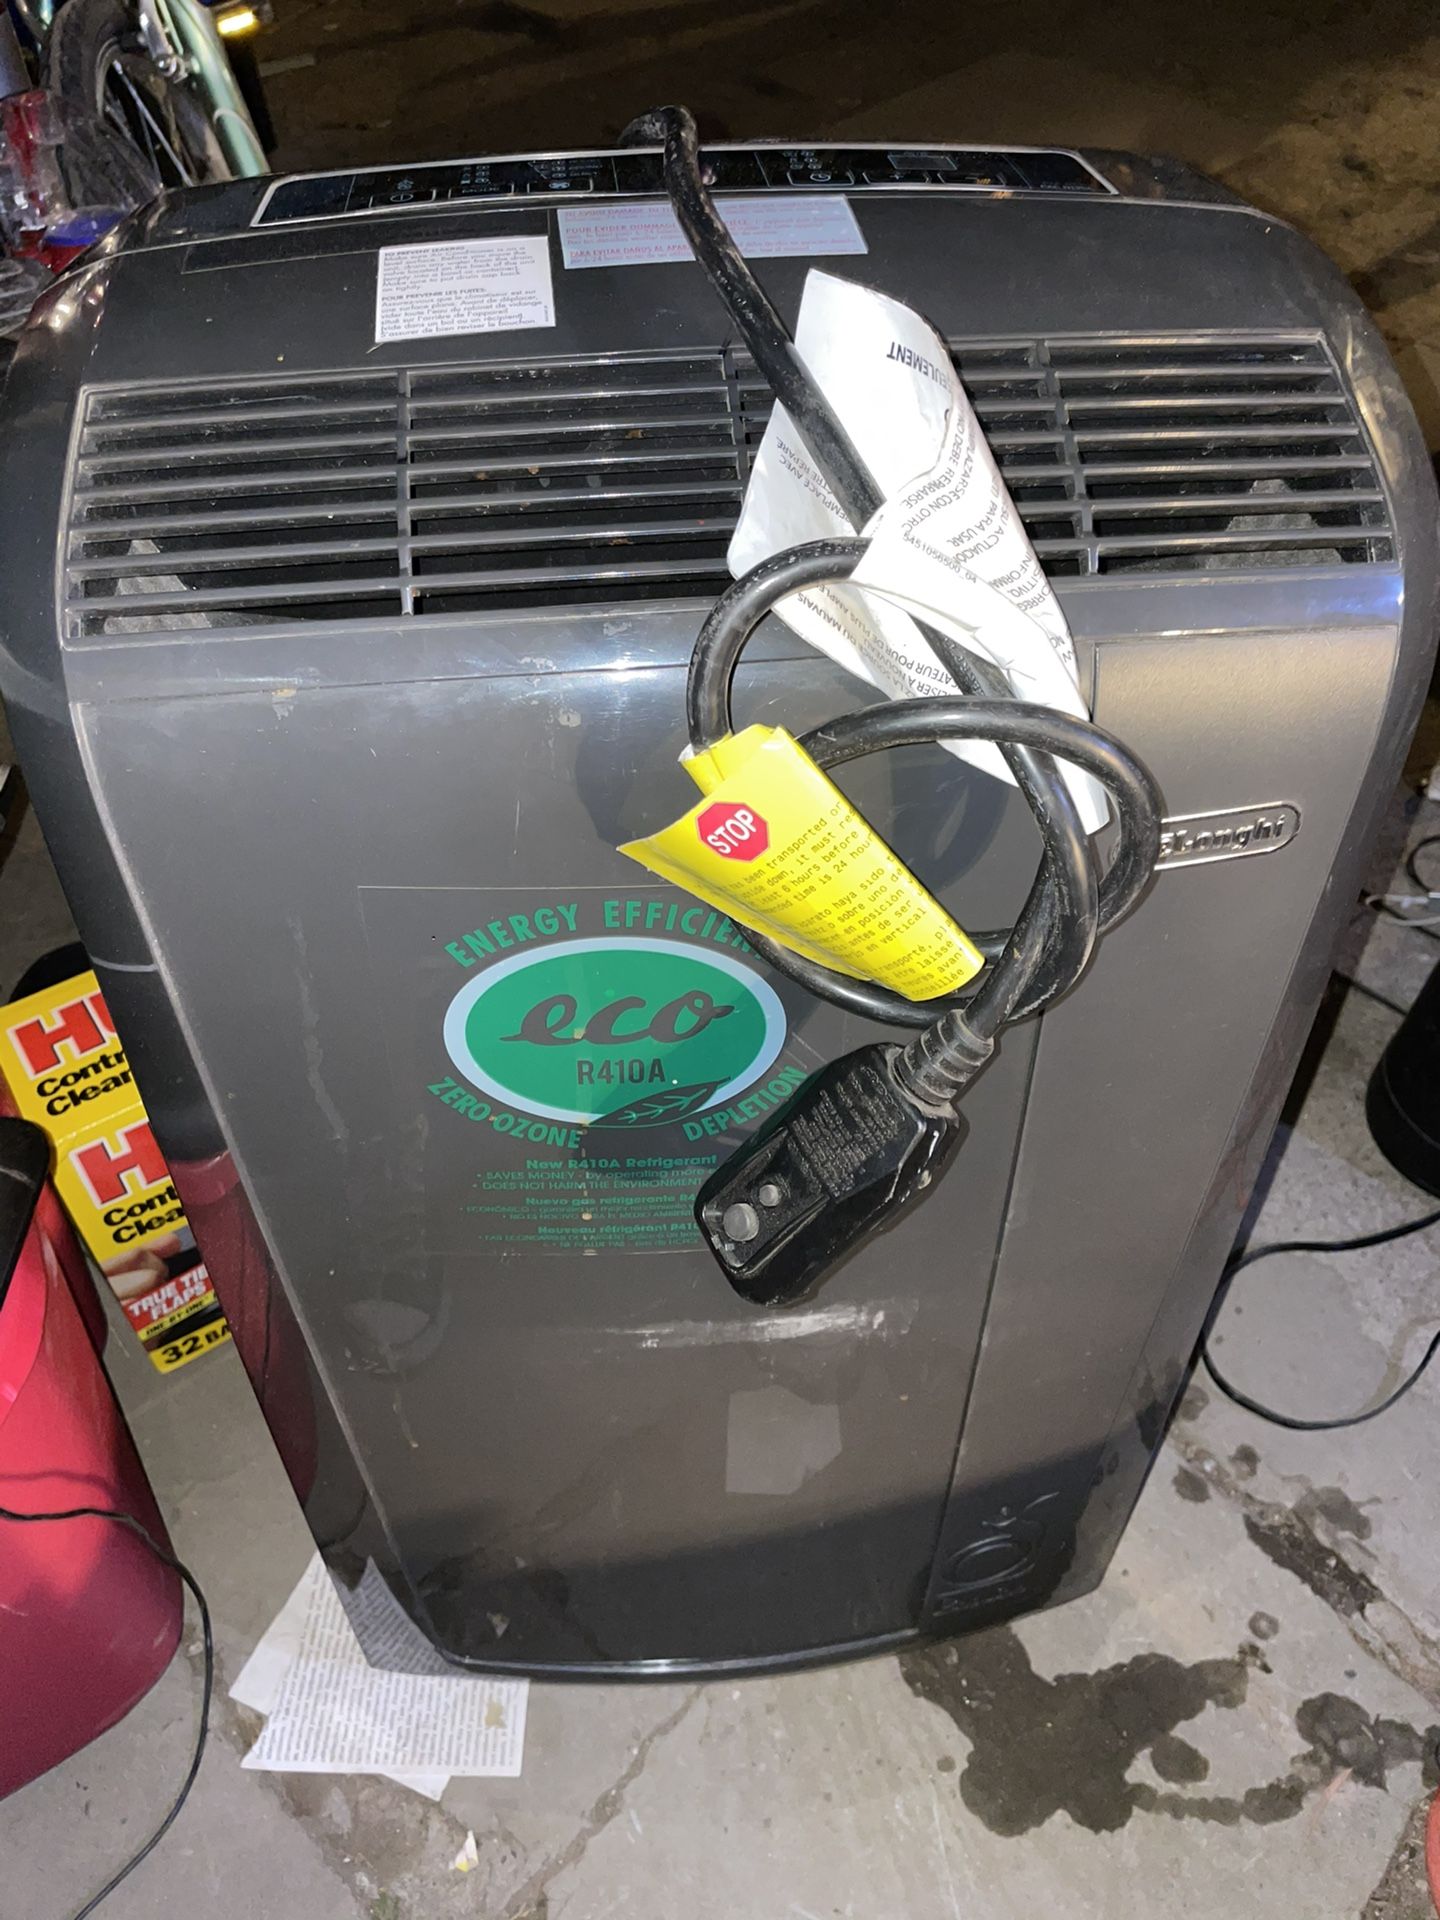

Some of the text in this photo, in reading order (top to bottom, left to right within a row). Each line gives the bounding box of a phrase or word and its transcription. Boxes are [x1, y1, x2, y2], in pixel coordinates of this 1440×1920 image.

[796, 592, 842, 633] MAUVAIS
[706, 808, 754, 855] STOP
[765, 817, 829, 870] transported
[809, 831, 837, 854] must
[790, 862, 822, 888] hours
[821, 831, 859, 864] before
[832, 859, 849, 874] 24
[831, 891, 859, 911] haya
[859, 867, 886, 892] sido
[836, 902, 867, 924] sobre
[867, 884, 889, 903] uno
[879, 907, 928, 945] vertical
[893, 899, 913, 919] ser
[444, 903, 579, 969] ENERGY
[499, 990, 736, 1047] eco
[576, 1057, 667, 1086] R410A
[426, 1064, 808, 1150] ZERO OZONE DEPLETION
[77, 1121, 171, 1206] H
[526, 1154, 717, 1170] New R410A Refrigerant
[528, 1171, 575, 1180] MONEY
[482, 1181, 517, 1191] DOES
[519, 1181, 545, 1190] NOT
[549, 1180, 586, 1190] HARM
[590, 1180, 610, 1189] THE
[128, 1281, 180, 1318] TRUE
[161, 1335, 204, 1364] 32
